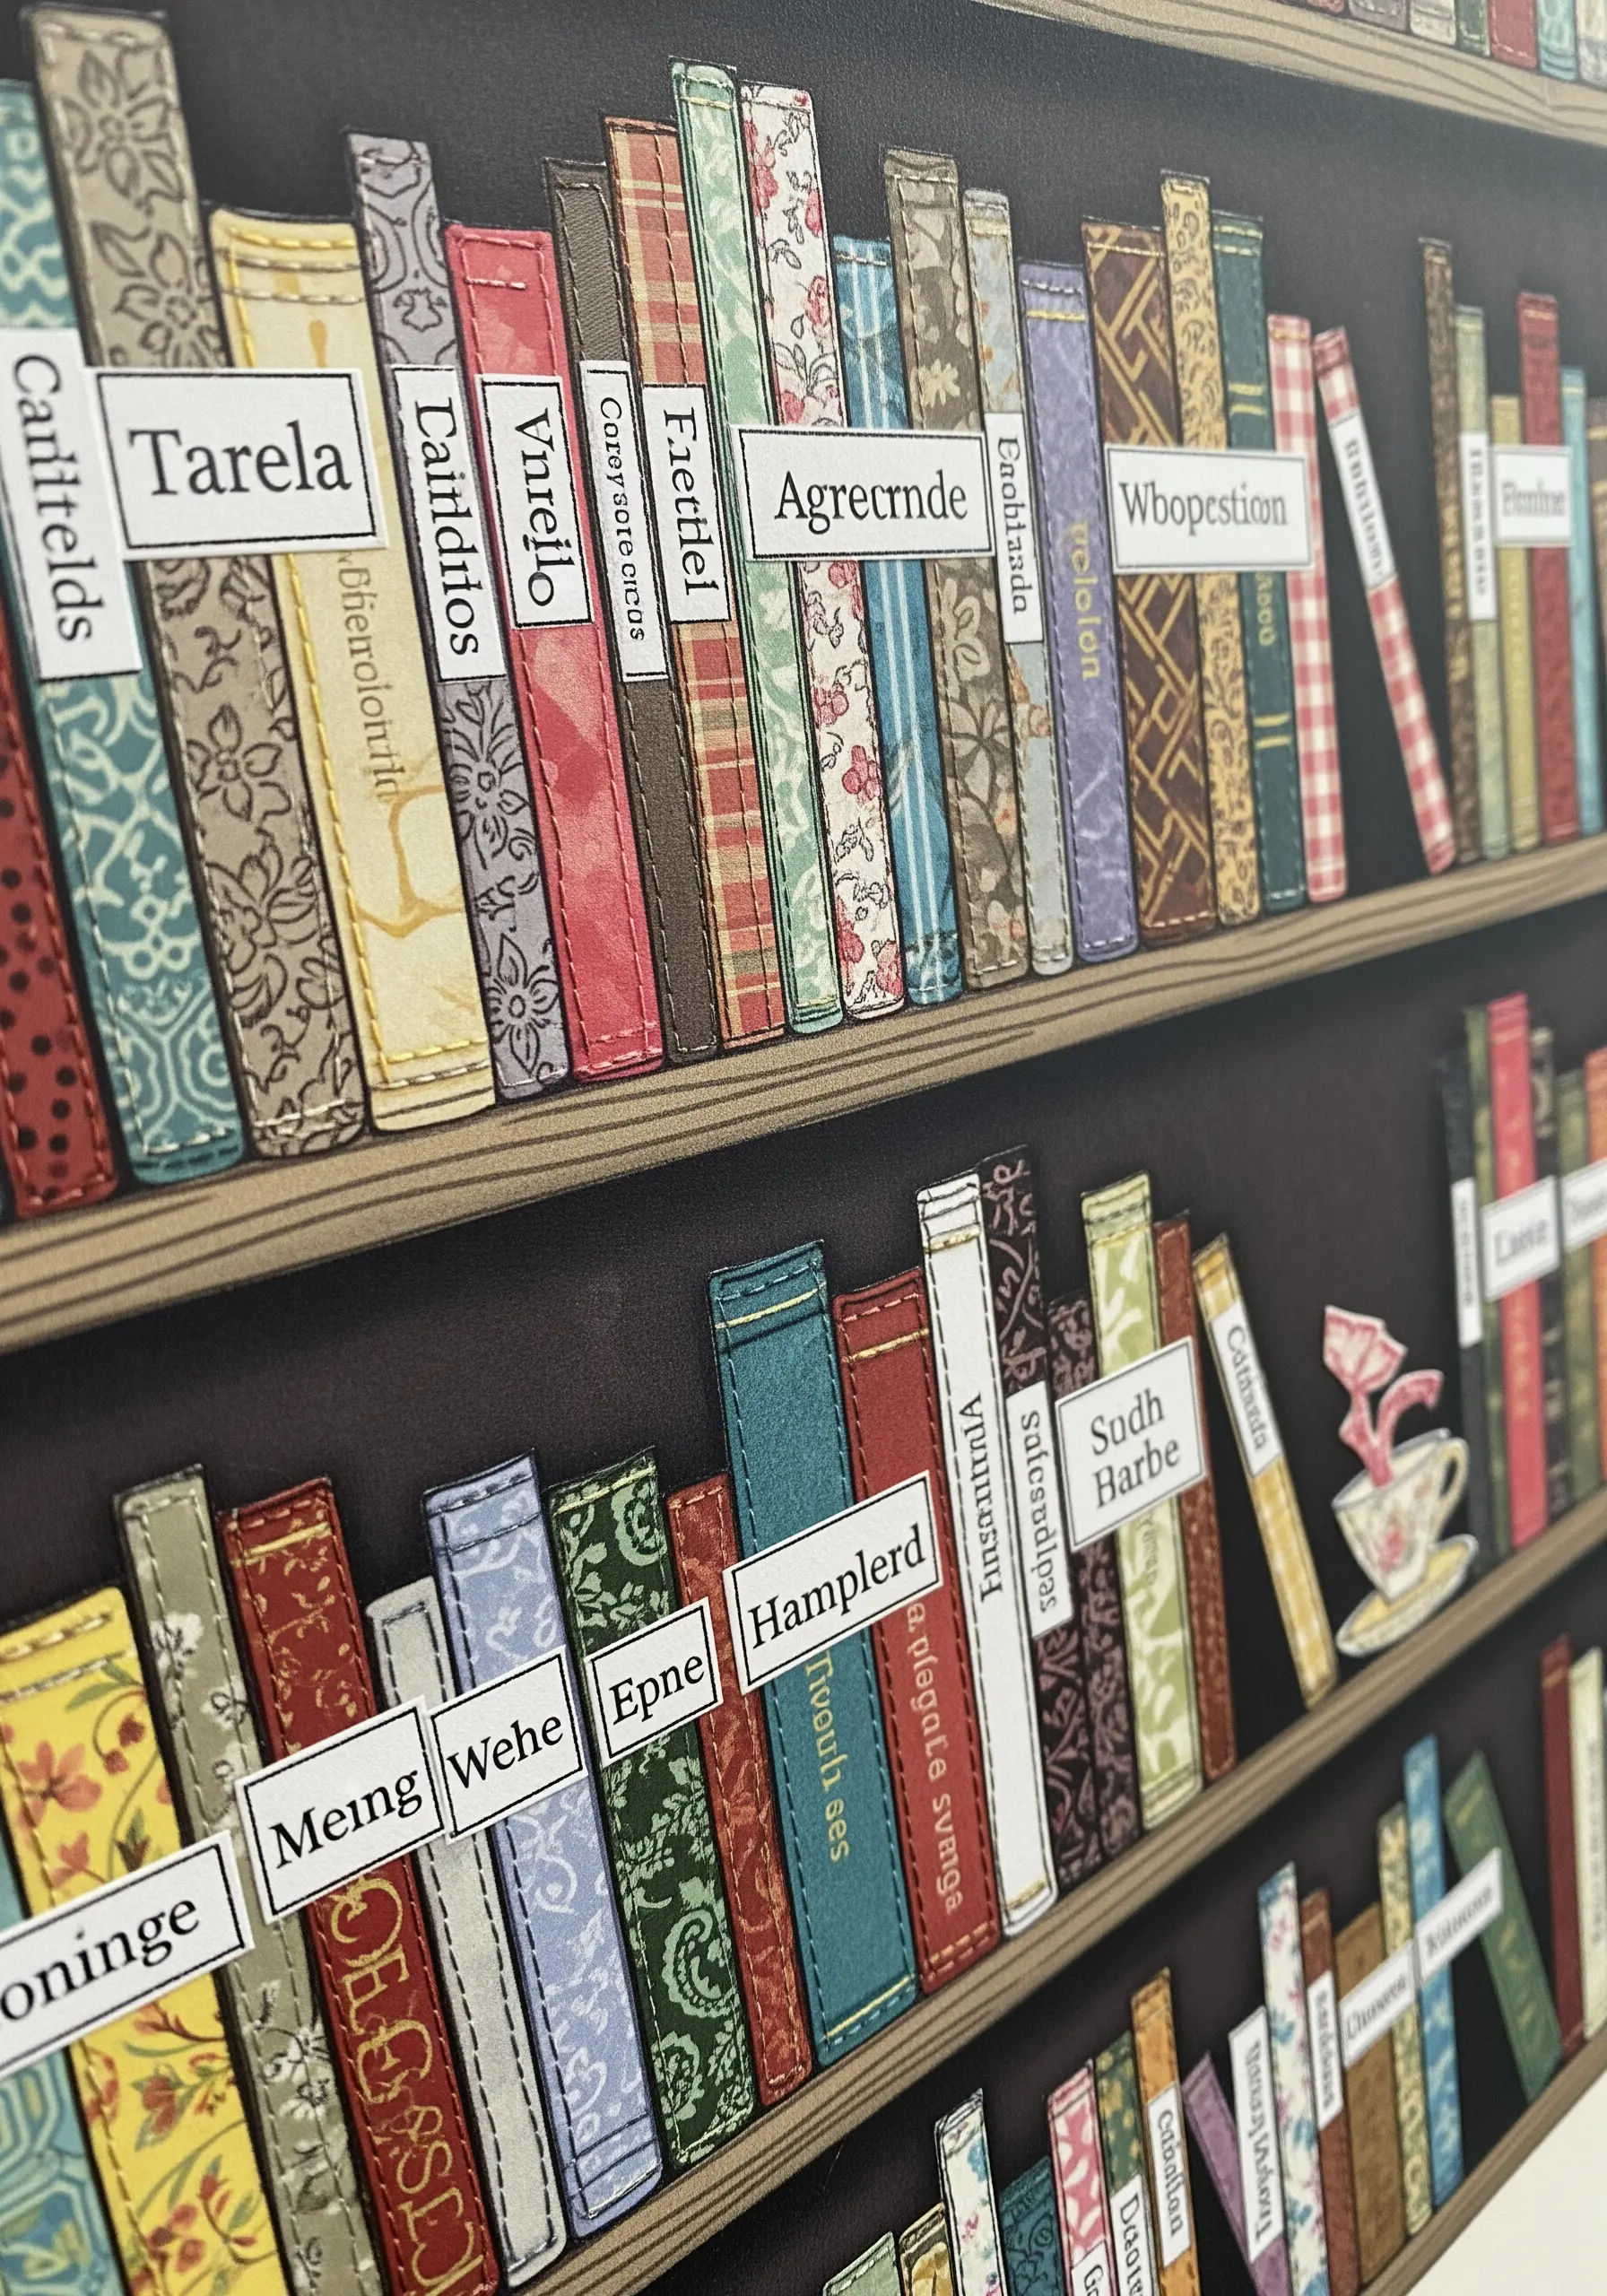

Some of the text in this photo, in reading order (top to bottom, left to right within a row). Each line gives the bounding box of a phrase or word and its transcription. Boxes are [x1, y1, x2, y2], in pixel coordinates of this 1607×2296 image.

[128, 419, 353, 496] Tarela
[747, 1523, 926, 1650] Hamplerd
[607, 1654, 706, 1726] Epne
[446, 1713, 565, 1790] Wehe
